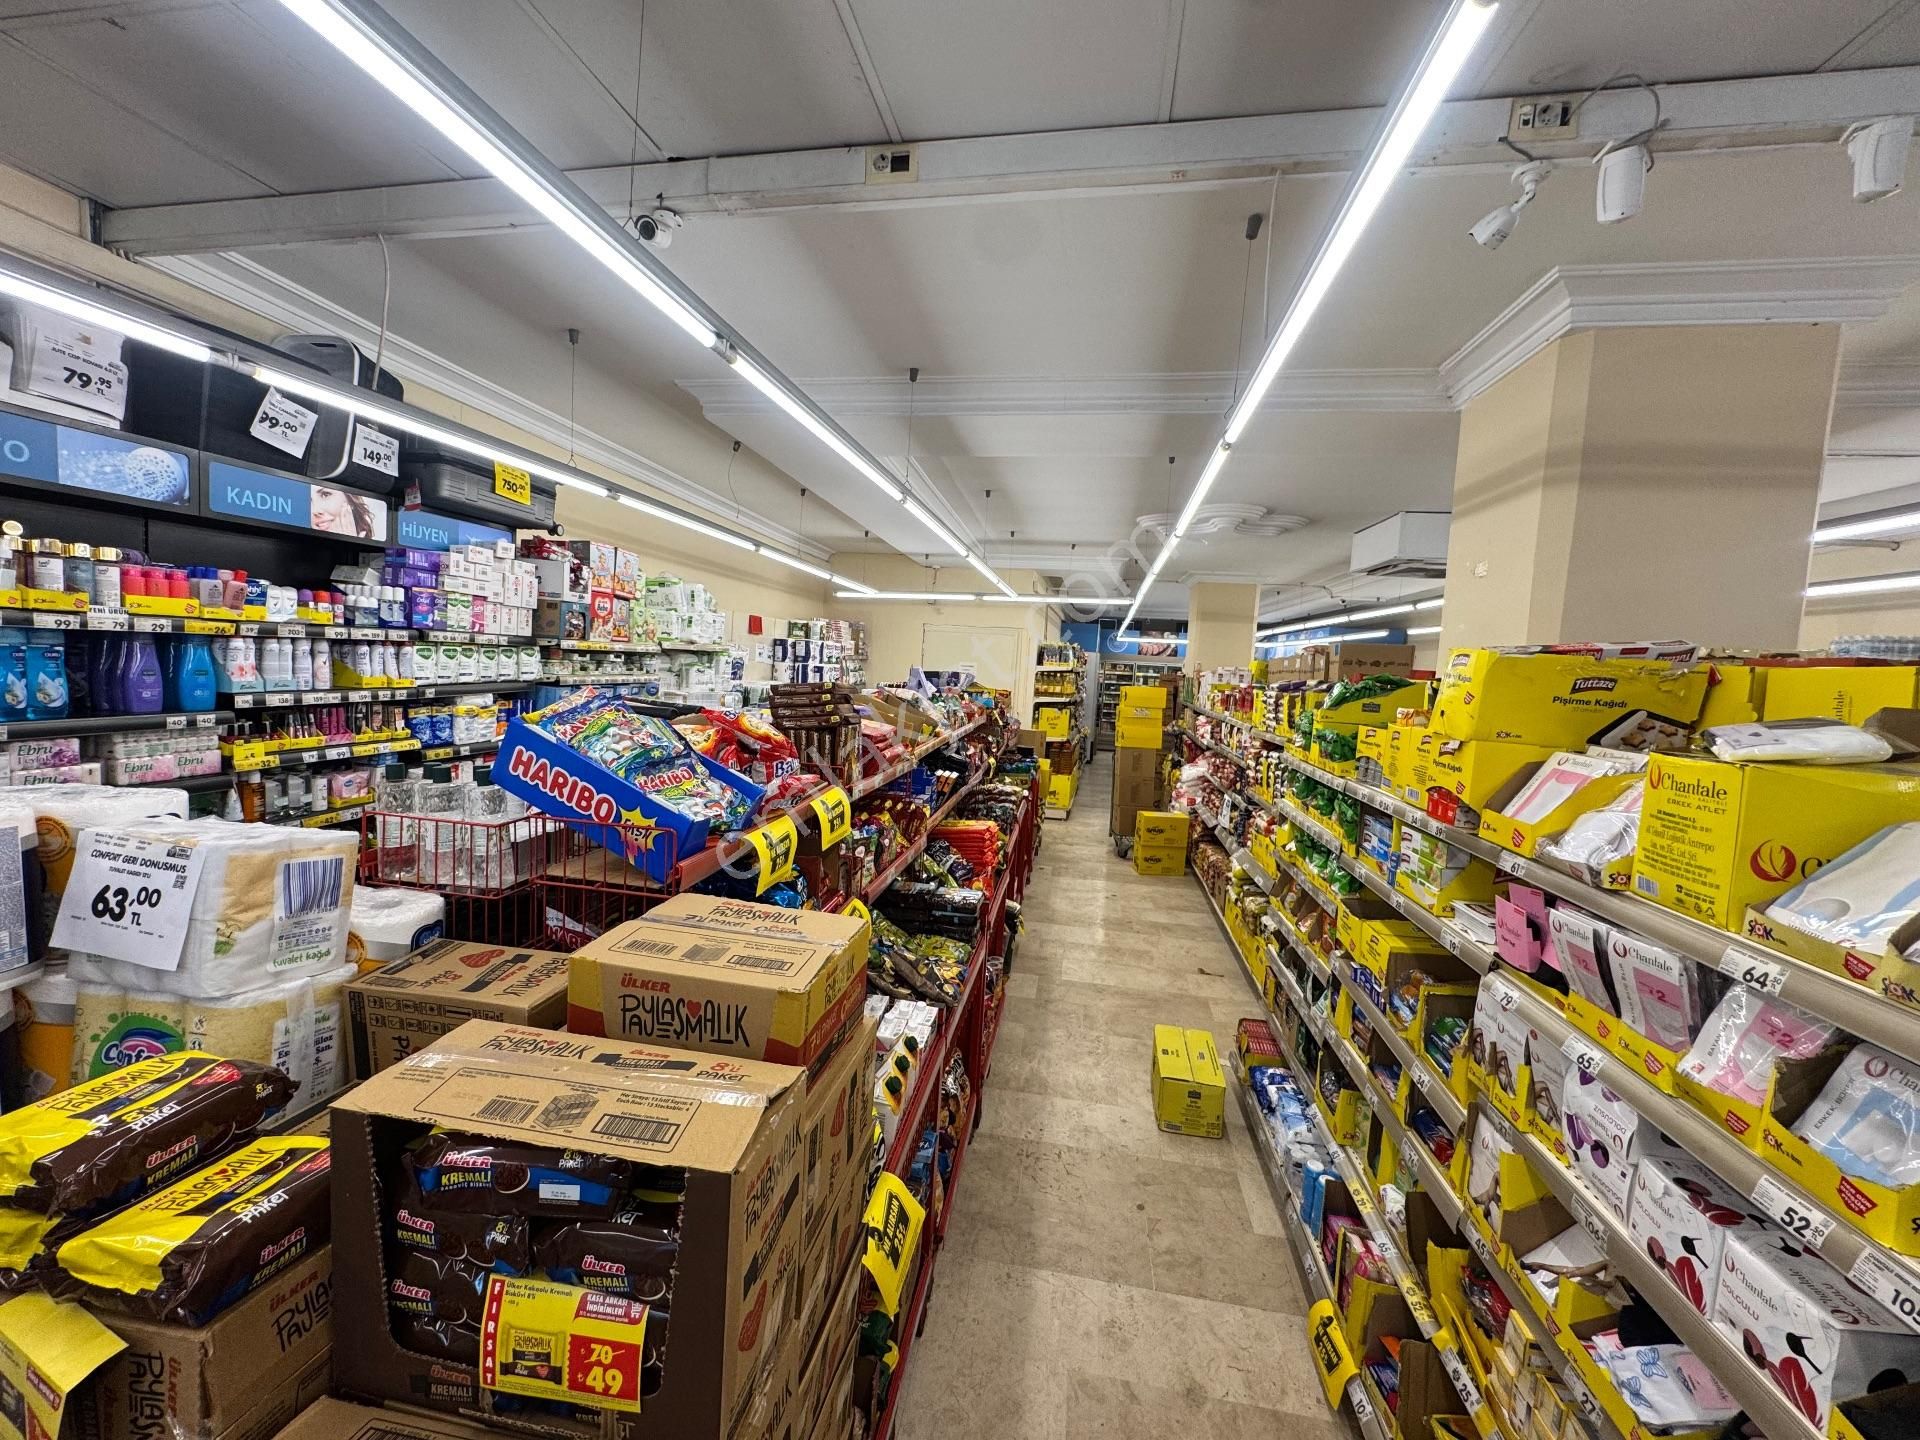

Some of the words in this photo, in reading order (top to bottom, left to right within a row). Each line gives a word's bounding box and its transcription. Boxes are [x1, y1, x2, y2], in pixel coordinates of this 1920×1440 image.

[226, 485, 292, 516] KADIN
[402, 520, 449, 545] HİJYEN
[54, 619, 73, 629] 99
[113, 621, 125, 630] 79
[151, 623, 165, 632] 29
[1574, 678, 1617, 691] Tuttaze
[1552, 695, 1592, 707] Pişirme
[1594, 698, 1628, 709] Kağıdı
[171, 719, 182, 727] 40
[202, 717, 212, 725] 40
[17, 744, 53, 757] Ebru
[336, 751, 347, 759] 99
[124, 761, 153, 774] Ebru
[177, 756, 203, 768] Ebru
[260, 759, 271, 767] 32
[509, 745, 618, 823] HARIBO
[637, 767, 695, 792] HARIBO
[1661, 772, 1728, 801] Chantale
[1667, 798, 1692, 809] ERKEK
[1695, 804, 1728, 815] ATLET
[1434, 827, 1443, 837] 39
[91, 848, 122, 862] CONFORT
[121, 855, 140, 866] GERI
[139, 858, 188, 874] DONUSMUS
[1510, 864, 1521, 875] 61
[91, 884, 163, 922] 63,00
[130, 910, 142, 927] TL
[1562, 921, 1592, 943] Chantale
[272, 953, 305, 968] tuvalet
[1628, 947, 1674, 975] Chantale
[620, 972, 672, 994] ÜLKER
[1742, 965, 1770, 990] 64
[1500, 992, 1513, 1006] 79
[629, 1048, 671, 1059] ÜLKER
[1577, 1052, 1594, 1070] 65
[696, 1071, 752, 1082] PAKET
[1415, 1074, 1427, 1090] 34
[130, 1100, 184, 1132] PAKET
[145, 1134, 198, 1169] ÜLKER
[441, 1151, 492, 1169] ÜLKER
[440, 1171, 492, 1187] KREMALI
[239, 1187, 290, 1225] PAKET
[397, 1209, 435, 1233] ÜLKER
[1780, 1206, 1811, 1239] 52
[259, 1226, 305, 1265] ÜLKER
[397, 1229, 436, 1246] KREMALI
[490, 1230, 511, 1245] PAKET
[1475, 1237, 1487, 1255] 45
[581, 1254, 626, 1276] ÜLKER
[506, 1280, 524, 1290] Ülker
[583, 1274, 629, 1288] KREMALI
[390, 1278, 431, 1302] ÜLKER
[1735, 1268, 1779, 1313] Chantale
[586, 1293, 604, 1302] KASA
[604, 1296, 628, 1307] ARKASI
[1720, 1278, 1760, 1321] DOLGULU
[586, 1302, 626, 1316] İNDİRİMLERİ
[590, 1343, 614, 1365] 70
[585, 1366, 624, 1396] 49
[431, 1383, 473, 1397] KREMALI
[1458, 1384, 1472, 1403] 25
[1579, 1392, 1597, 1413] 27
